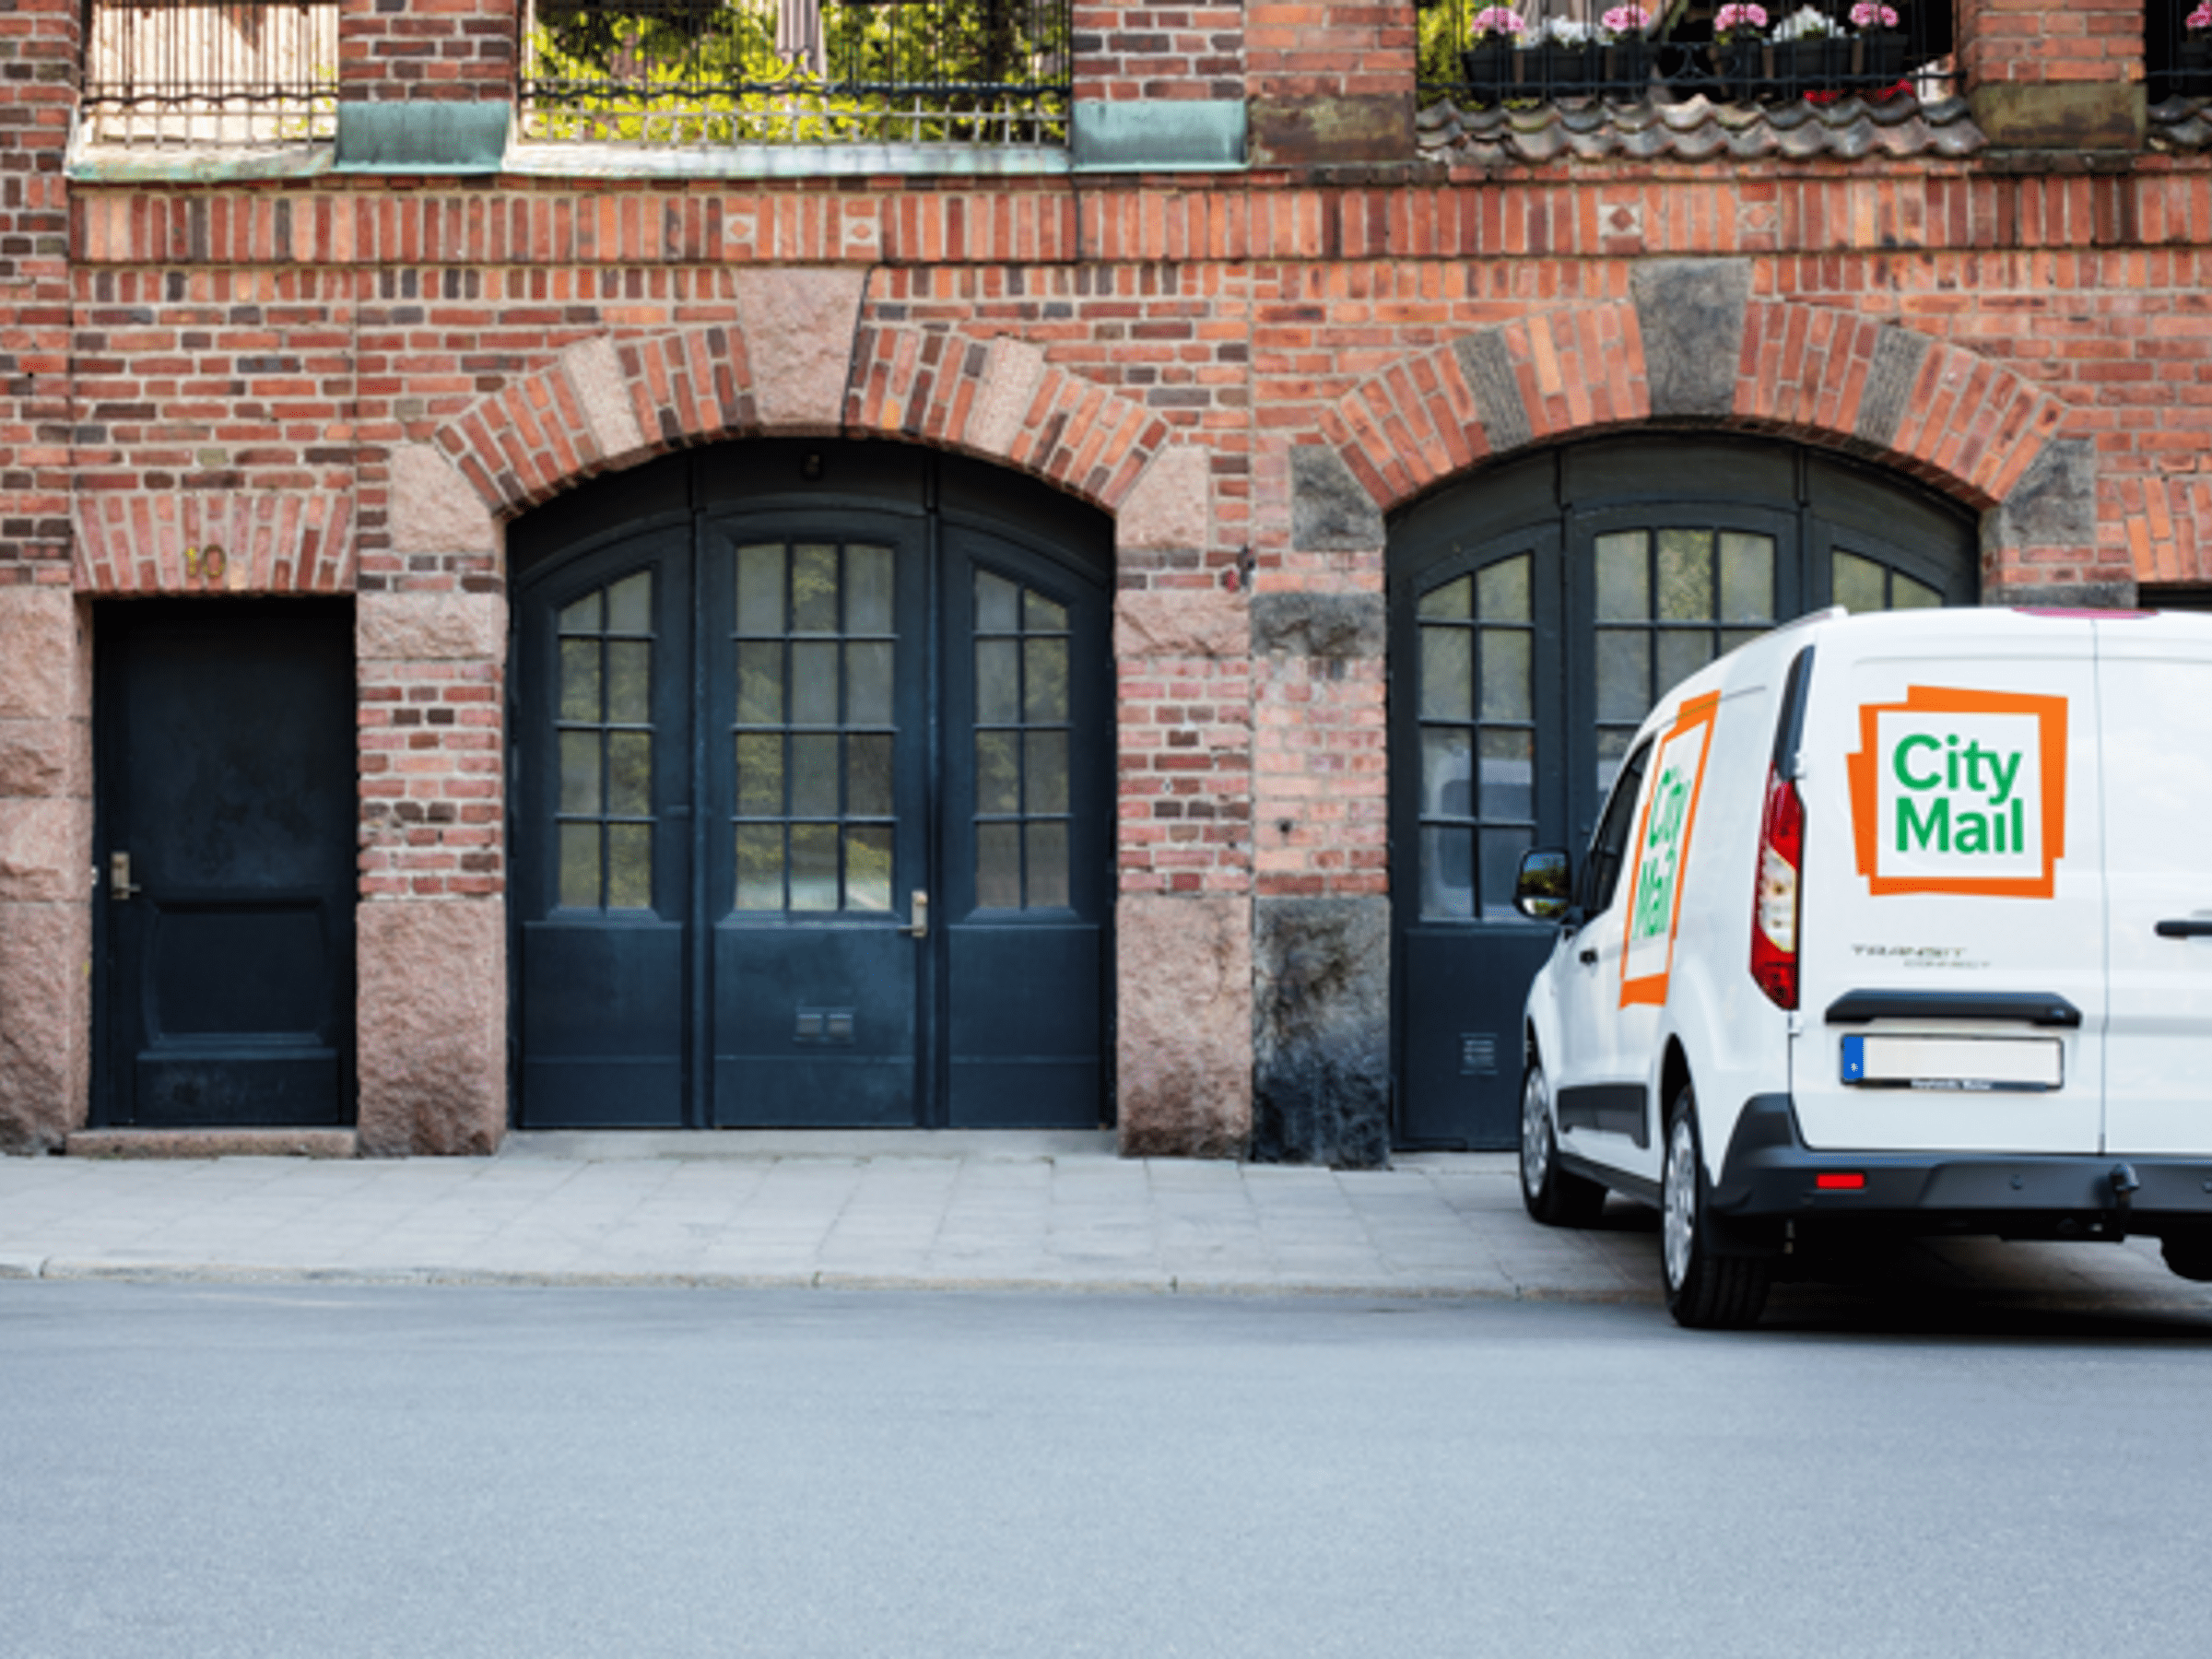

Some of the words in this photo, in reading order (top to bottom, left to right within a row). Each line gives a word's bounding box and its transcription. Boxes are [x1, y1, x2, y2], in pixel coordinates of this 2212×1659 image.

[184, 545, 226, 580] 10
[1893, 734, 2022, 806] City
[1896, 796, 2024, 854] Mail
